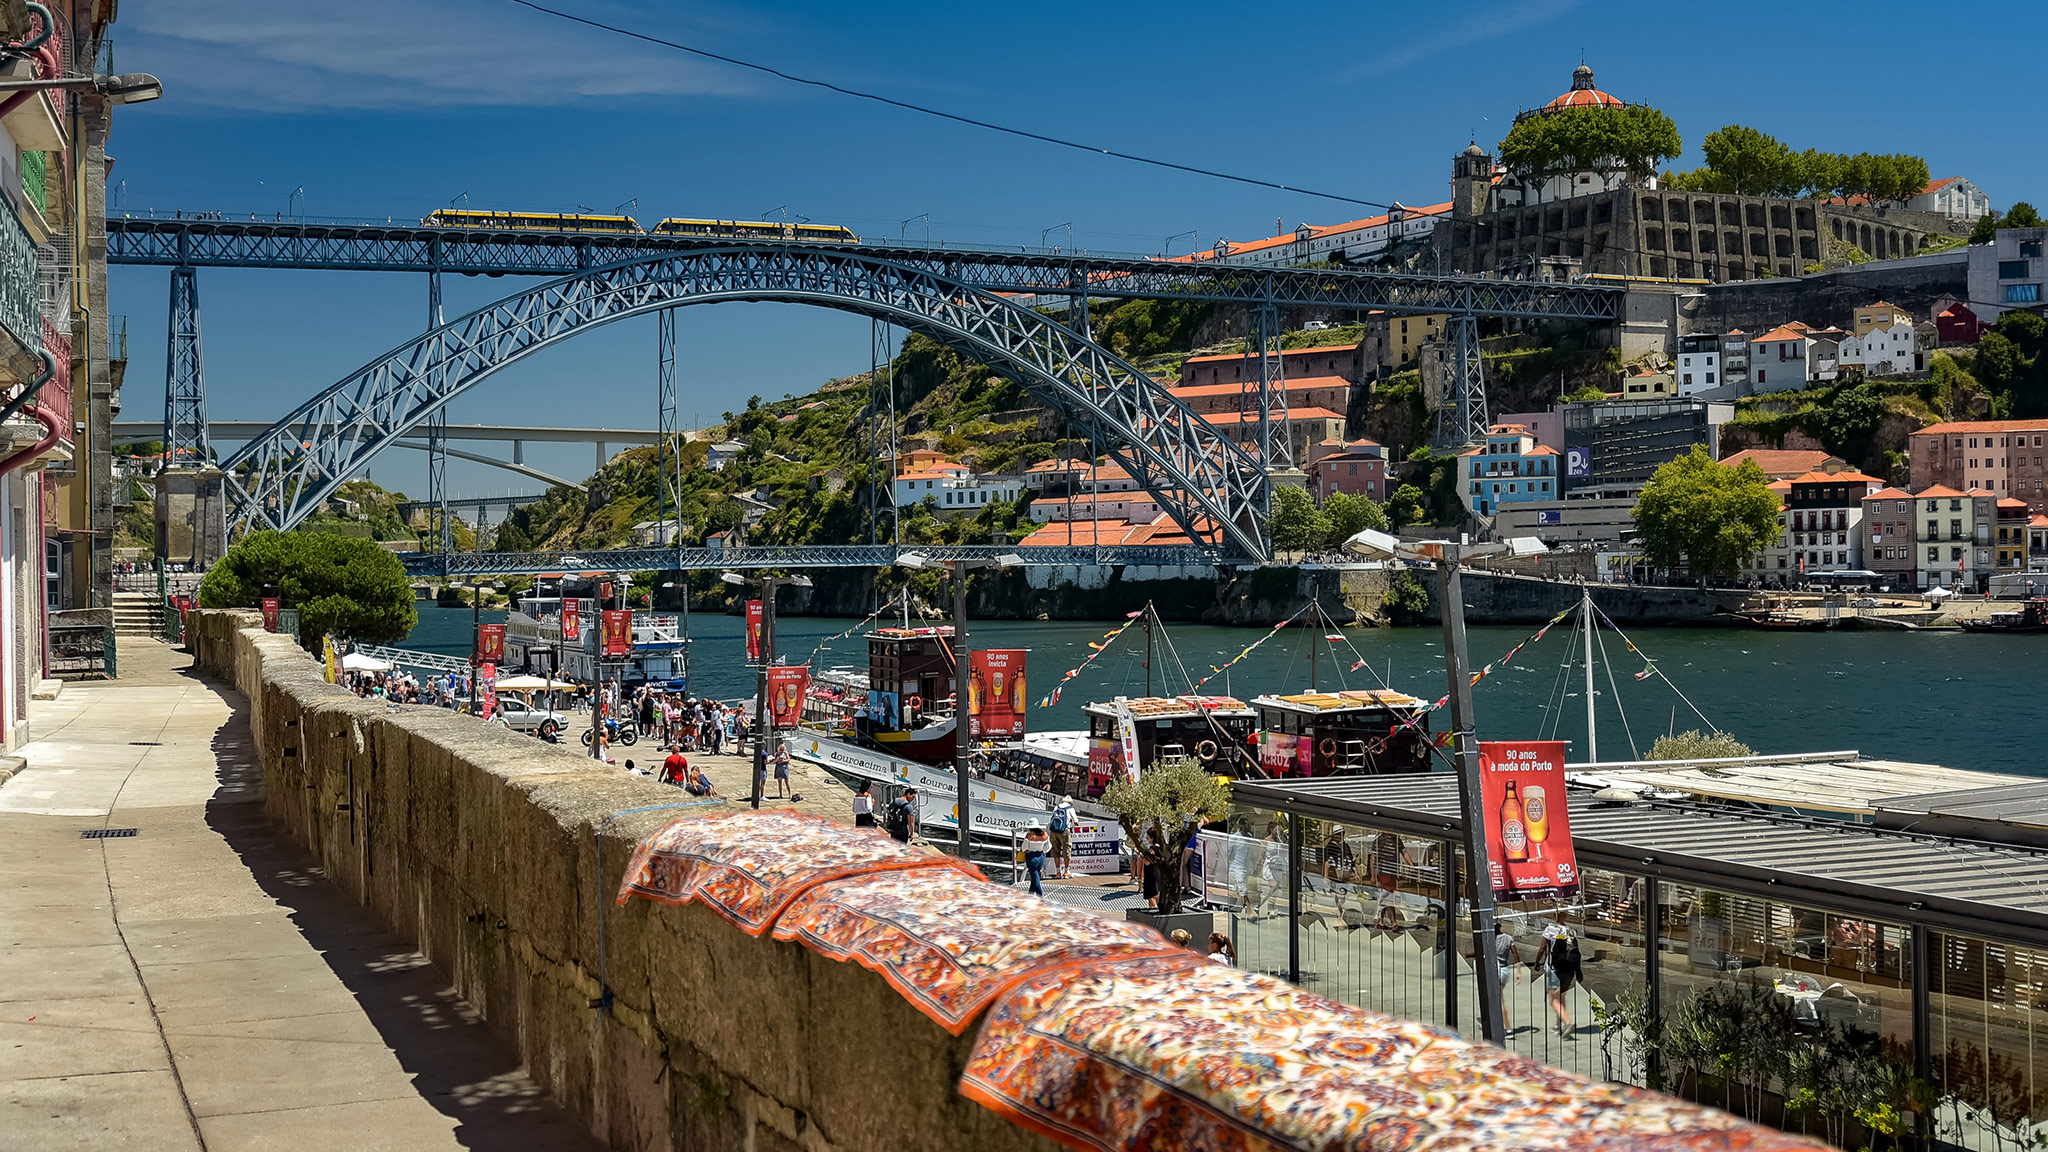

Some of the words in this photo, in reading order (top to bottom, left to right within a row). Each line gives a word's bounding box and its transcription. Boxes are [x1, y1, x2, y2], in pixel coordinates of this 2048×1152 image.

[1568, 451, 1582, 475] P
[1539, 512, 1547, 523] P
[1264, 753, 1290, 768] CRUZ
[1506, 749, 1517, 760] 90
[1518, 751, 1537, 760] anos
[831, 751, 888, 774] douroacima
[1090, 761, 1113, 776] CRUZ
[1490, 761, 1496, 772] à
[1497, 762, 1519, 771] moda
[1520, 761, 1530, 771] do
[1531, 760, 1552, 771] Porto
[1557, 863, 1571, 873] 90
